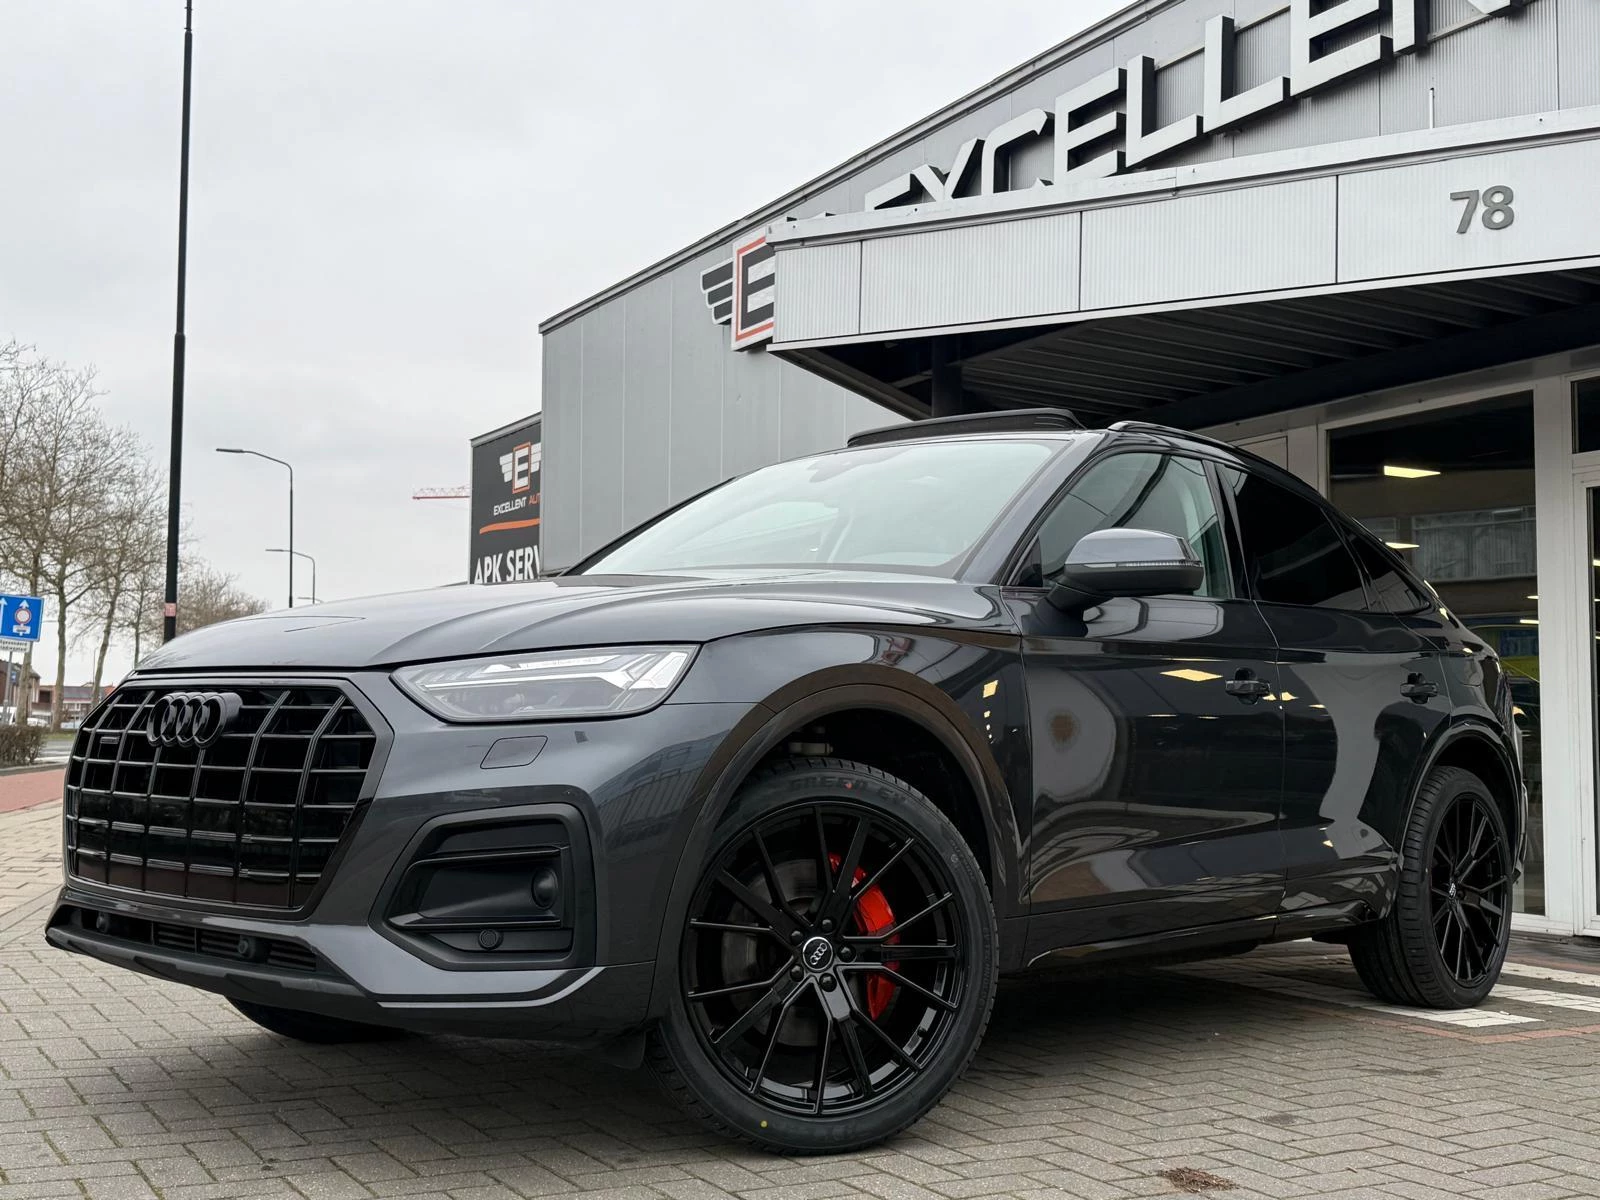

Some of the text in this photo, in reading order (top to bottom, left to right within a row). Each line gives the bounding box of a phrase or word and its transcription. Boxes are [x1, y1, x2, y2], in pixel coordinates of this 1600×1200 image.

[1450, 185, 1515, 234] 78
[493, 496, 527, 516] EXCELLENT
[474, 552, 504, 585] APK
